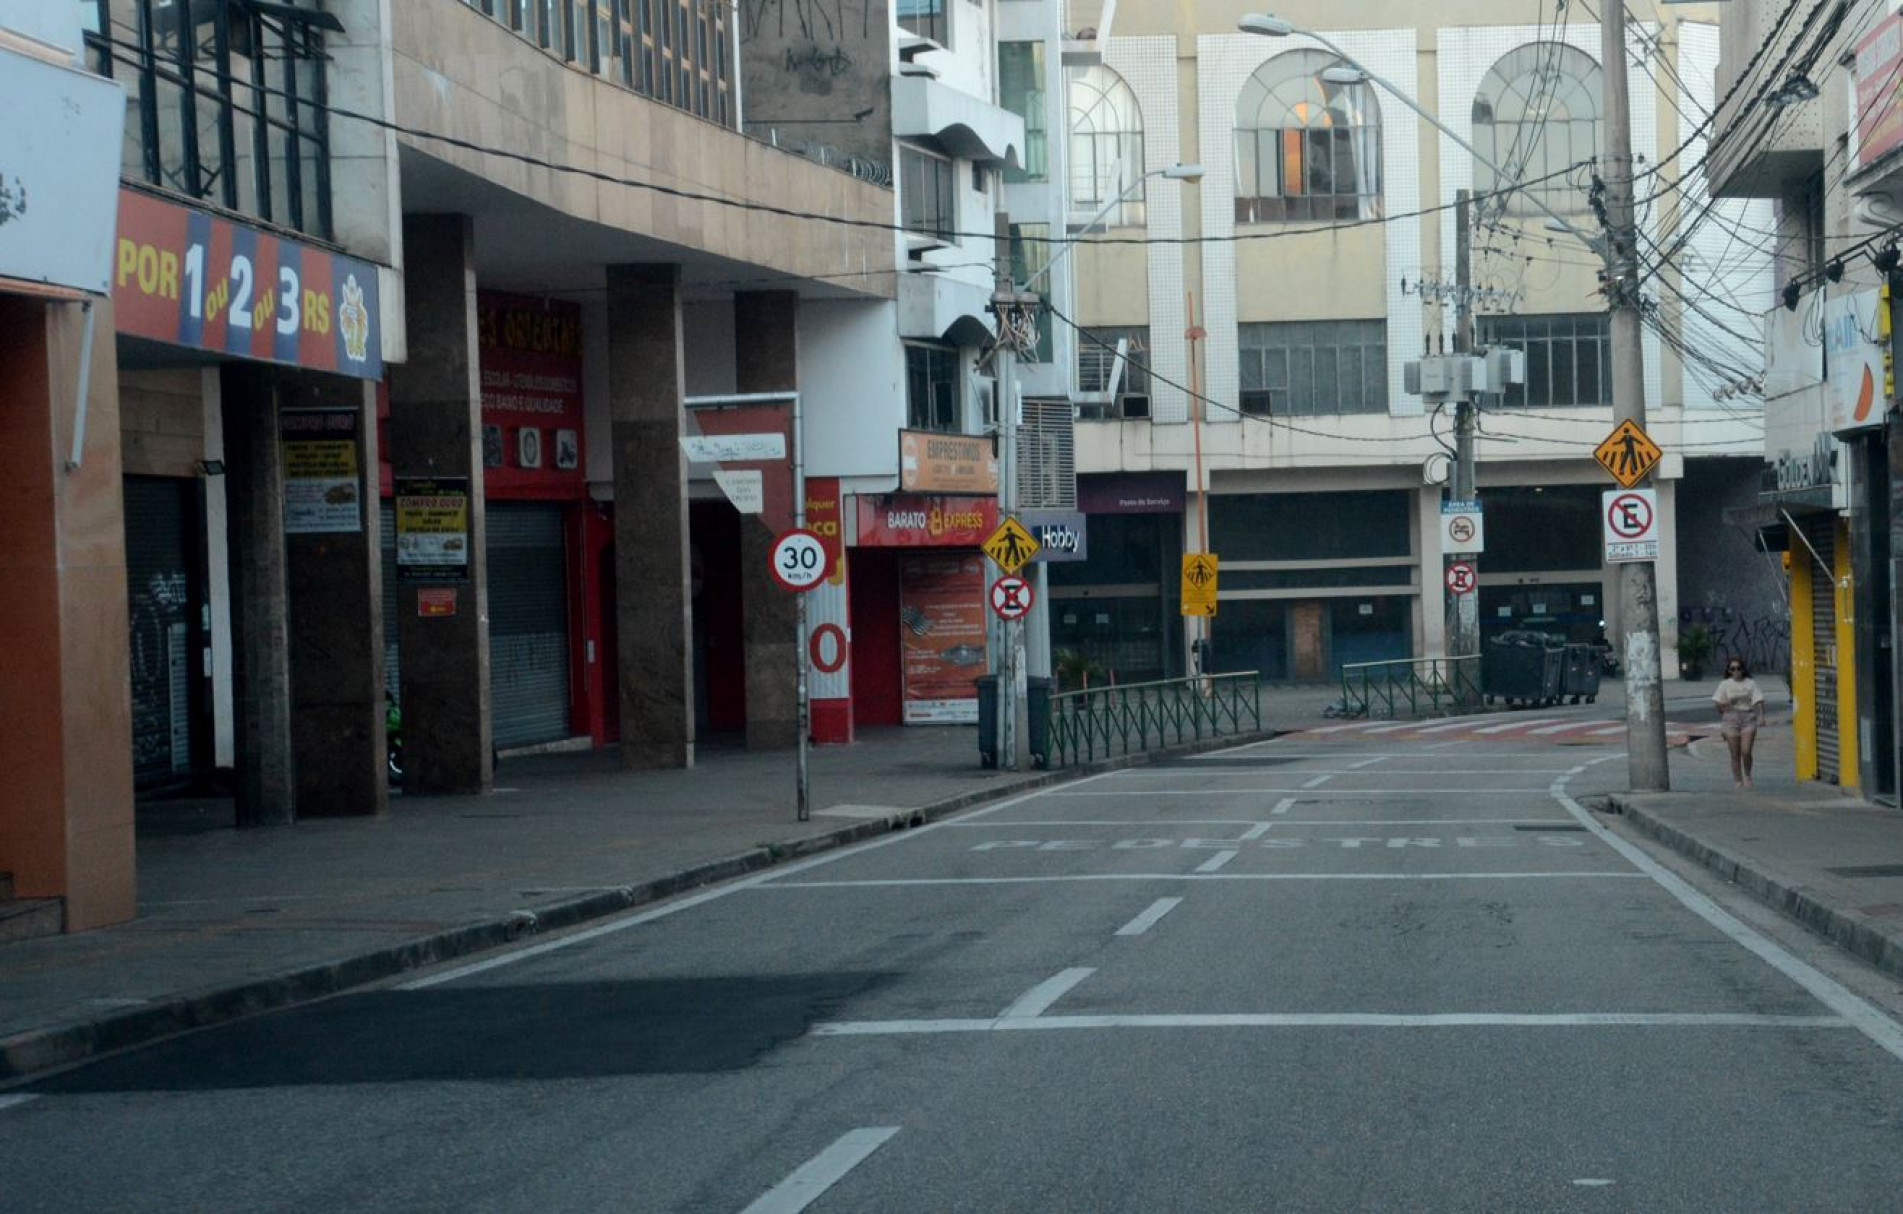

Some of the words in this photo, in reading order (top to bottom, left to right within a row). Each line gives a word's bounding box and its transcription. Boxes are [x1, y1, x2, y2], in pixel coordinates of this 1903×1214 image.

[118, 237, 178, 299] POR
[184, 243, 205, 318] 1
[206, 277, 228, 322] ou
[229, 255, 253, 328] 2
[254, 287, 273, 331] ou
[277, 266, 300, 335] 3
[303, 287, 330, 336] R$
[887, 511, 926, 529] BARATO
[945, 512, 983, 530] EXPRESS
[1042, 525, 1080, 553] Hobby
[784, 546, 817, 569] 30
